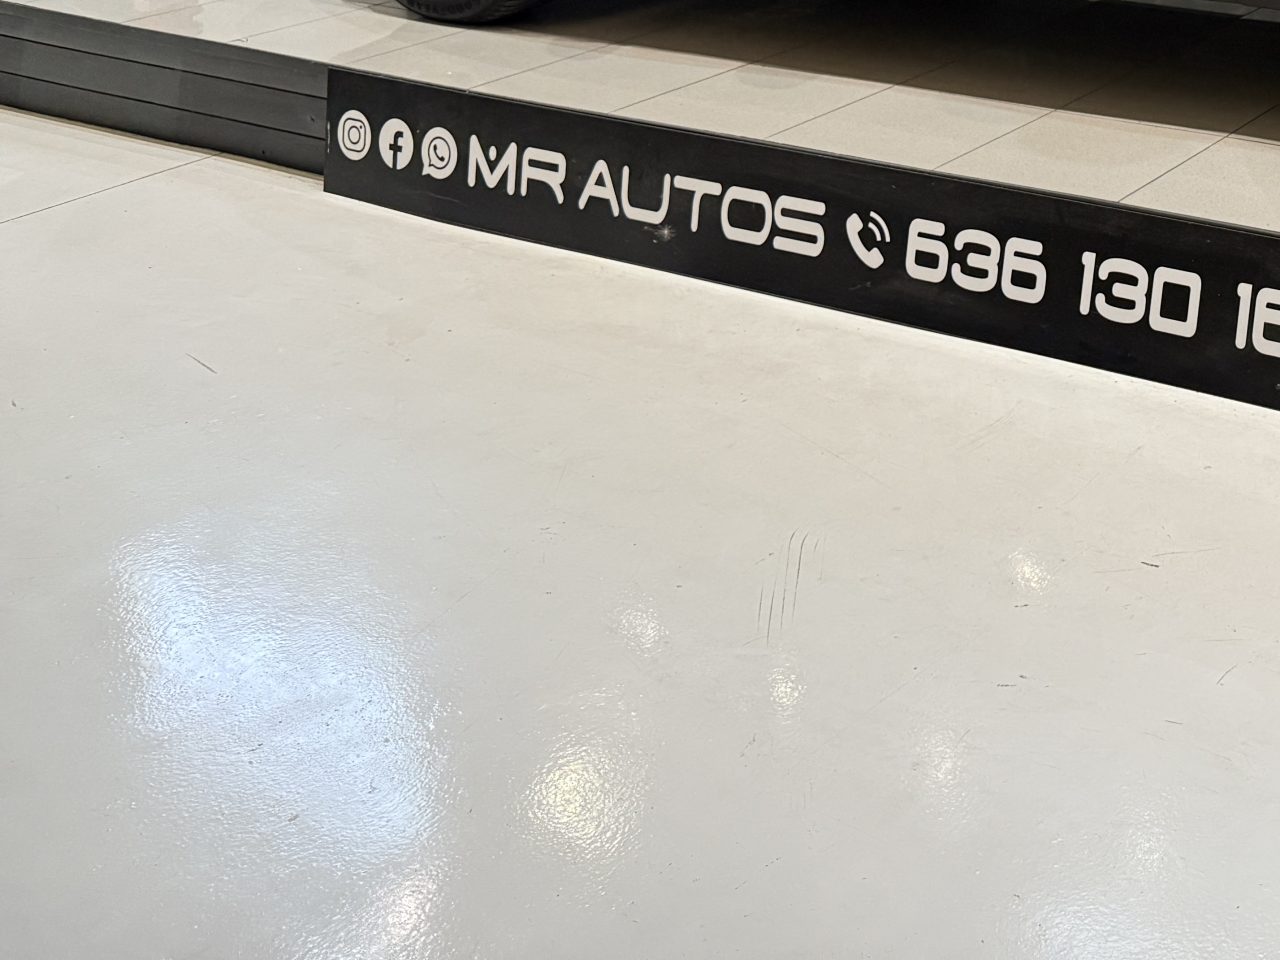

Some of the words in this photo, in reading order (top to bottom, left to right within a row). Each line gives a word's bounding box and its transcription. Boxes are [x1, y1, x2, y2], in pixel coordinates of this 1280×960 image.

[467, 134, 567, 204] MR
[578, 159, 826, 257] AUTOS
[905, 218, 1047, 304] 636
[1079, 251, 1202, 338] 130
